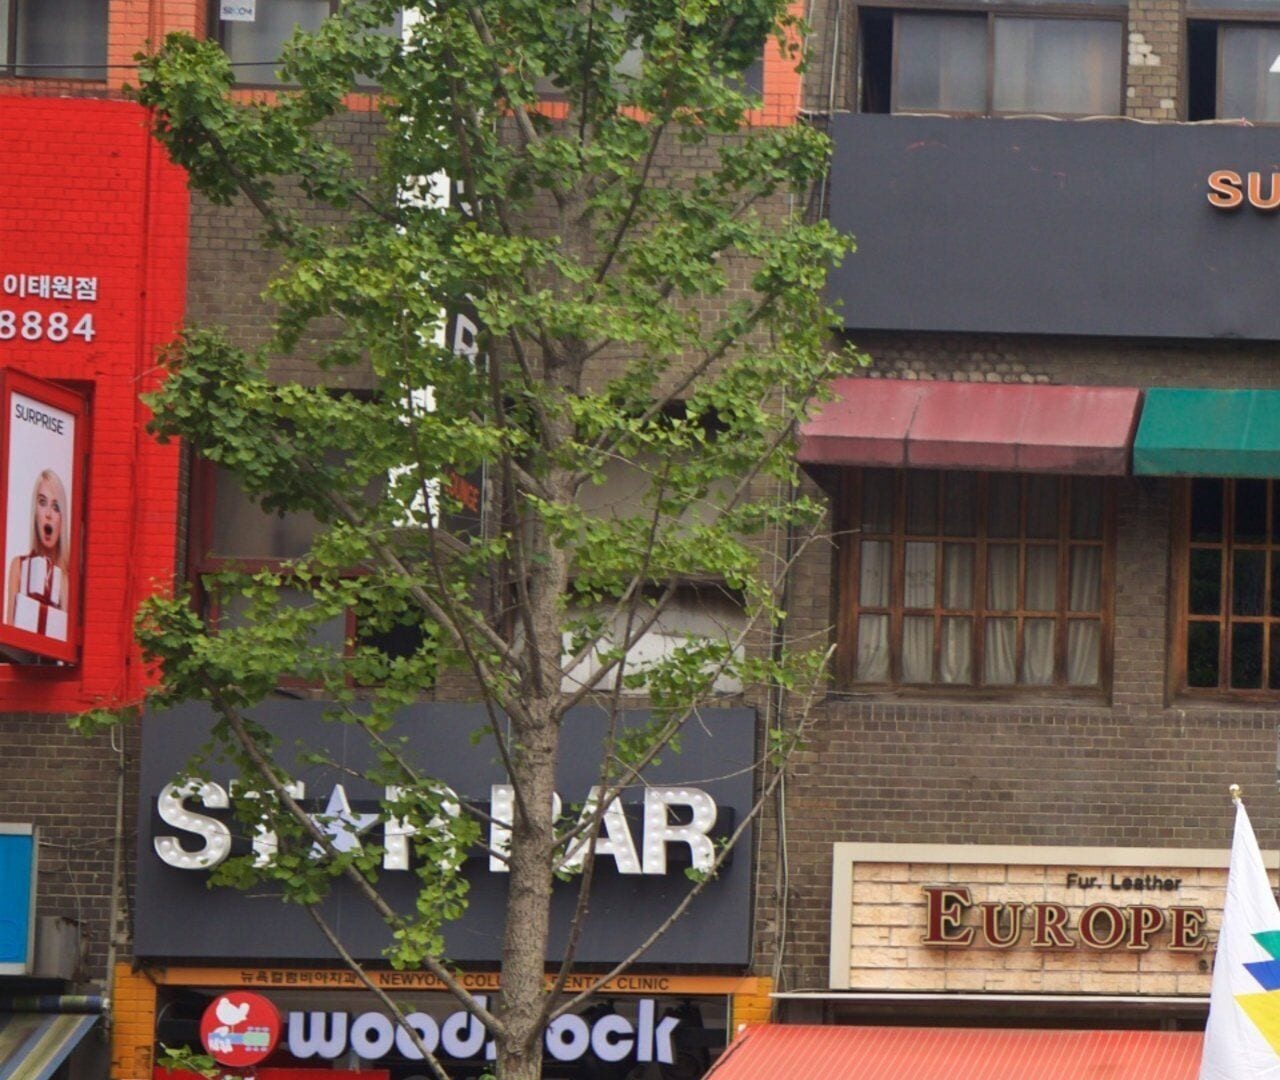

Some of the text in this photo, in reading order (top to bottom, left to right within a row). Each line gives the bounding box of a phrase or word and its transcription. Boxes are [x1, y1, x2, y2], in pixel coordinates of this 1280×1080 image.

[3, 273, 97, 301] 이태원점
[15, 403, 64, 435] SURPRISE
[1110, 874, 1181, 891] Leather
[616, 977, 669, 991] CLINIC
